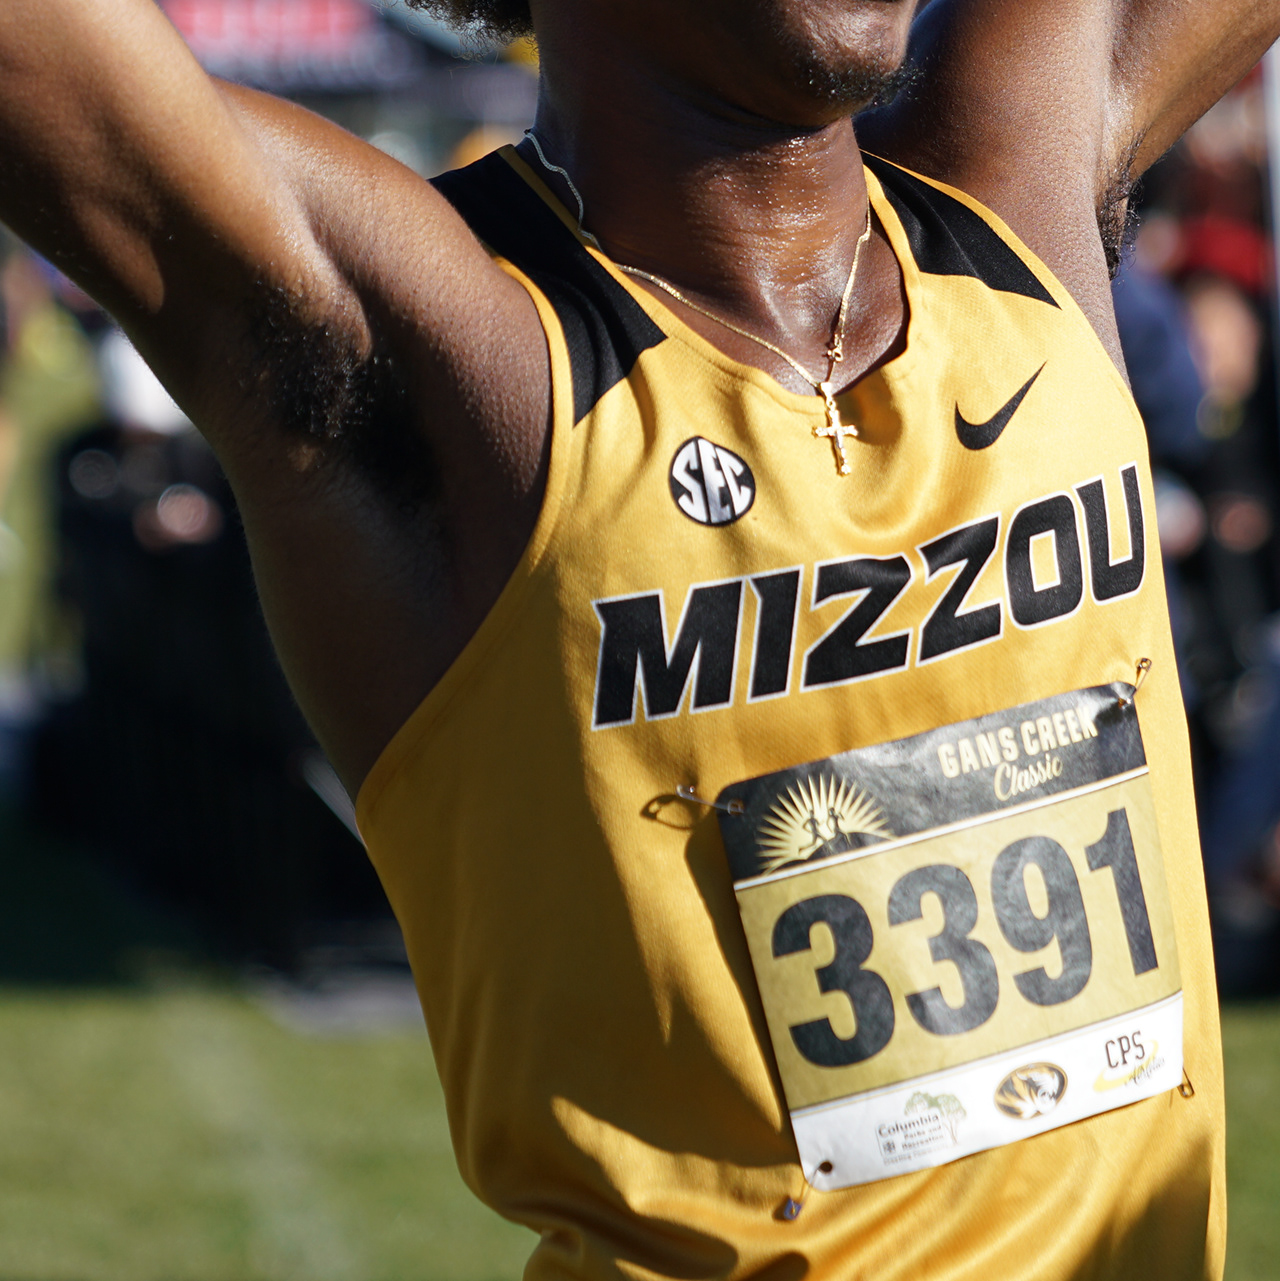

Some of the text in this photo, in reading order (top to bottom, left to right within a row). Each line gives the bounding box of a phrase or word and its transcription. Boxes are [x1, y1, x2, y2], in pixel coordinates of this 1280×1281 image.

[672, 439, 751, 523] SEC
[592, 461, 1146, 731] MIZZOU
[937, 706, 1099, 778] GANS CREEK
[993, 753, 1063, 802] Classic
[771, 807, 1159, 1068] 3391
[1105, 1030, 1145, 1068] CPS
[878, 1114, 939, 1138] Columbia
